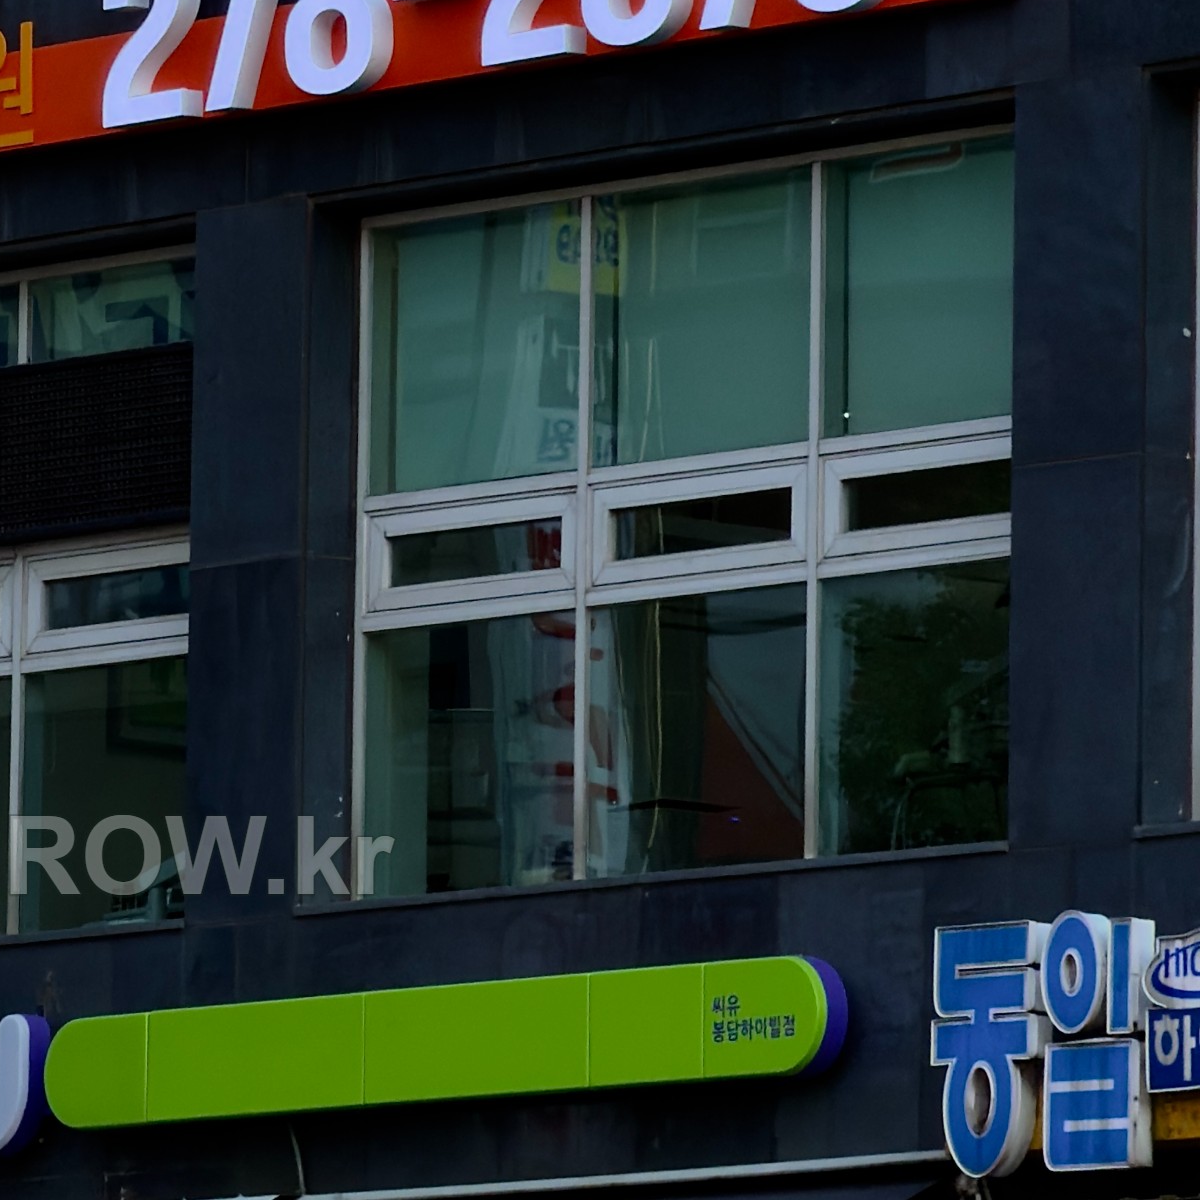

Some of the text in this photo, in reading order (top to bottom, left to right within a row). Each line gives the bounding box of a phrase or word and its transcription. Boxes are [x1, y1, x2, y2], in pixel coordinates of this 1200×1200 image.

[711, 995, 740, 1018] 씨유
[930, 909, 1156, 1179] 동일
[1154, 1014, 1200, 1082] 하
